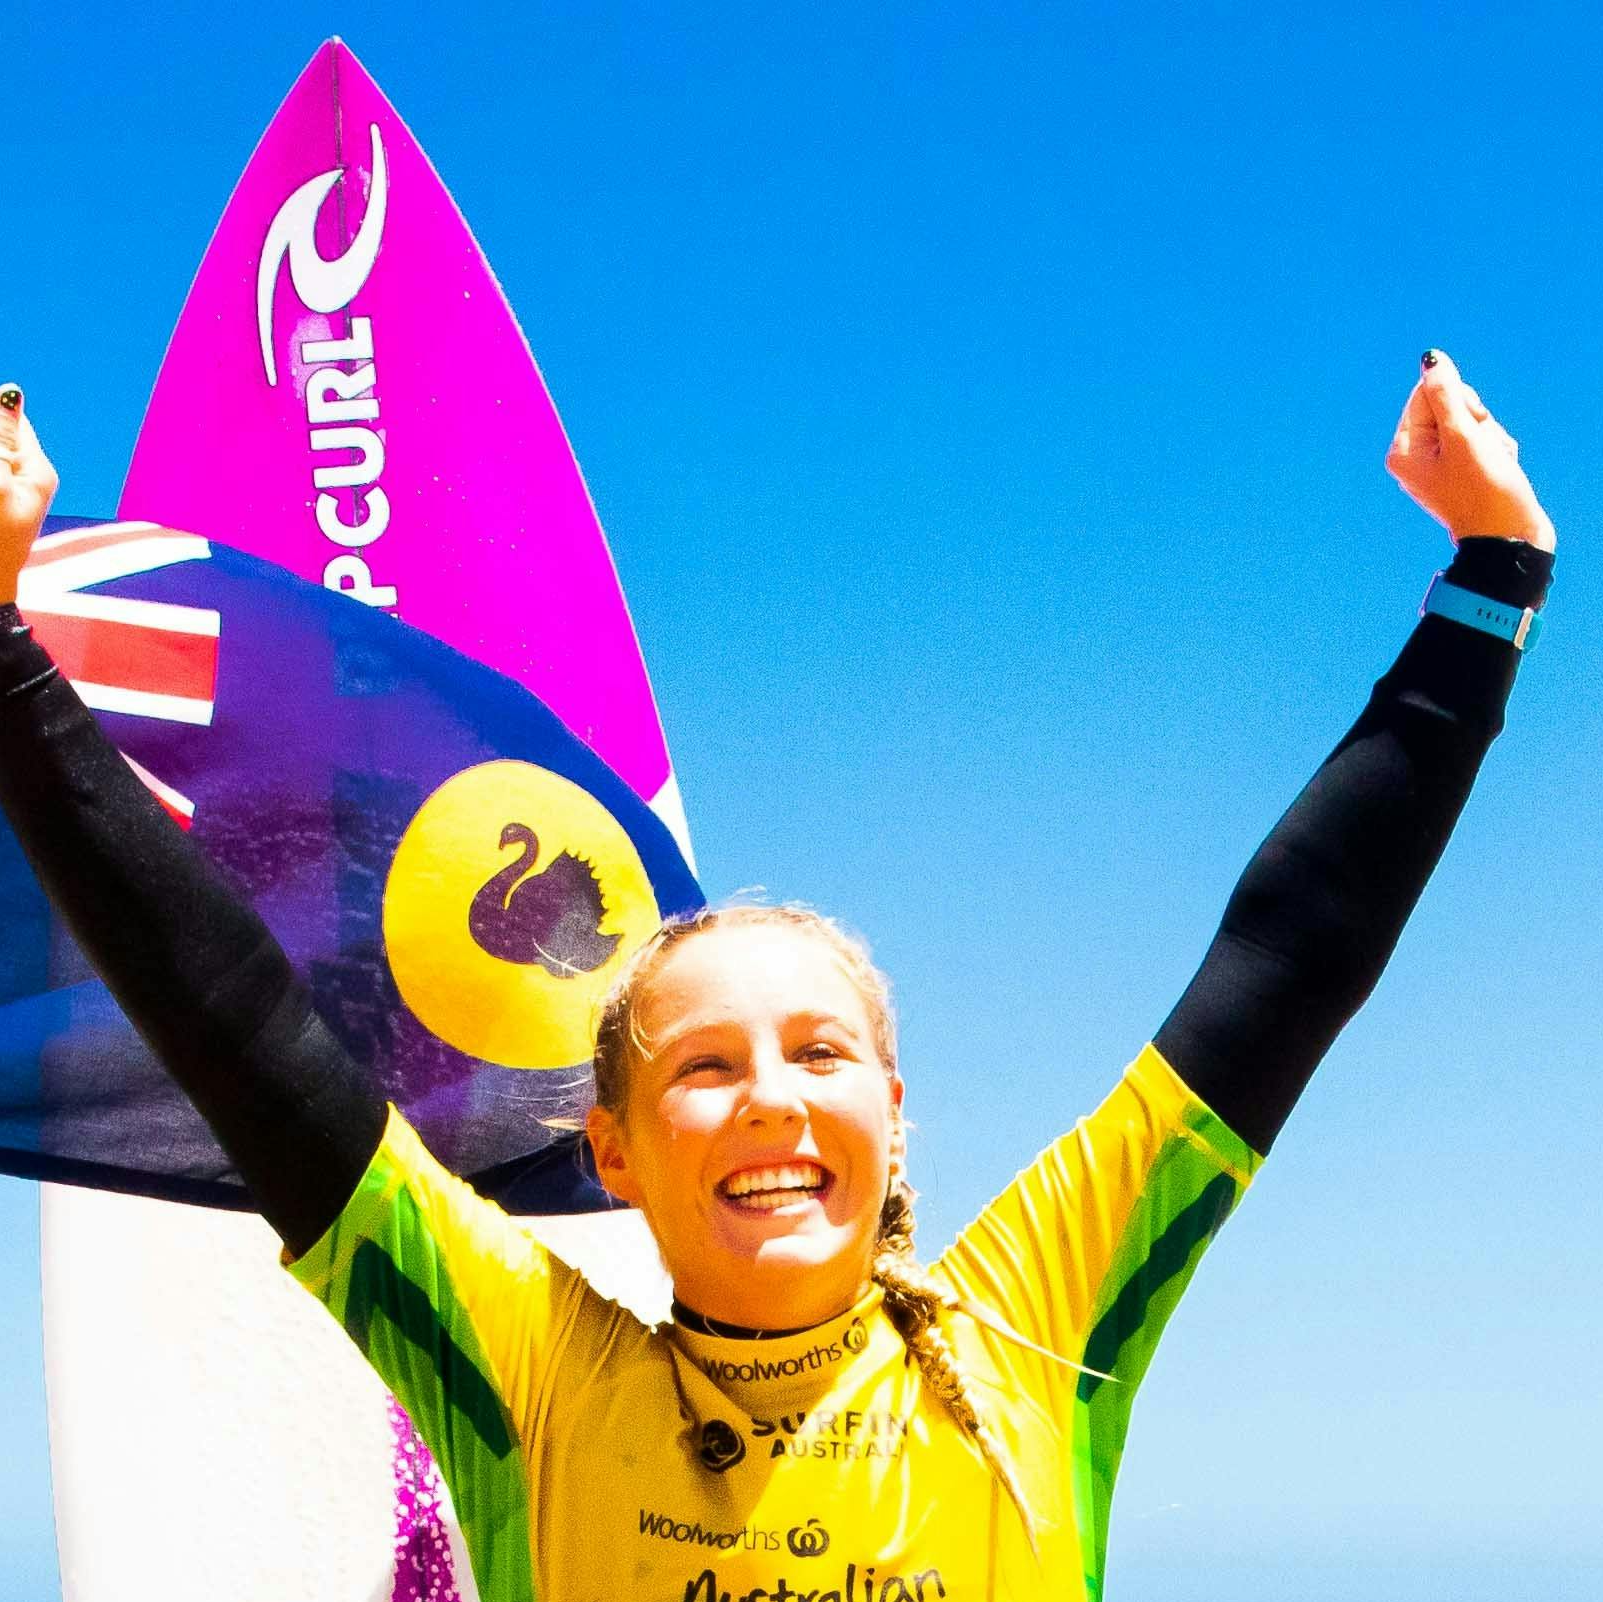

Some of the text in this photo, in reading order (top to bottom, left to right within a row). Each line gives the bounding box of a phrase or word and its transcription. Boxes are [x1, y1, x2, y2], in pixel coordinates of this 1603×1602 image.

[704, 1342, 842, 1382] Woolworths
[750, 1410, 908, 1438] SURFIN
[638, 1509, 781, 1552] Woolworths
